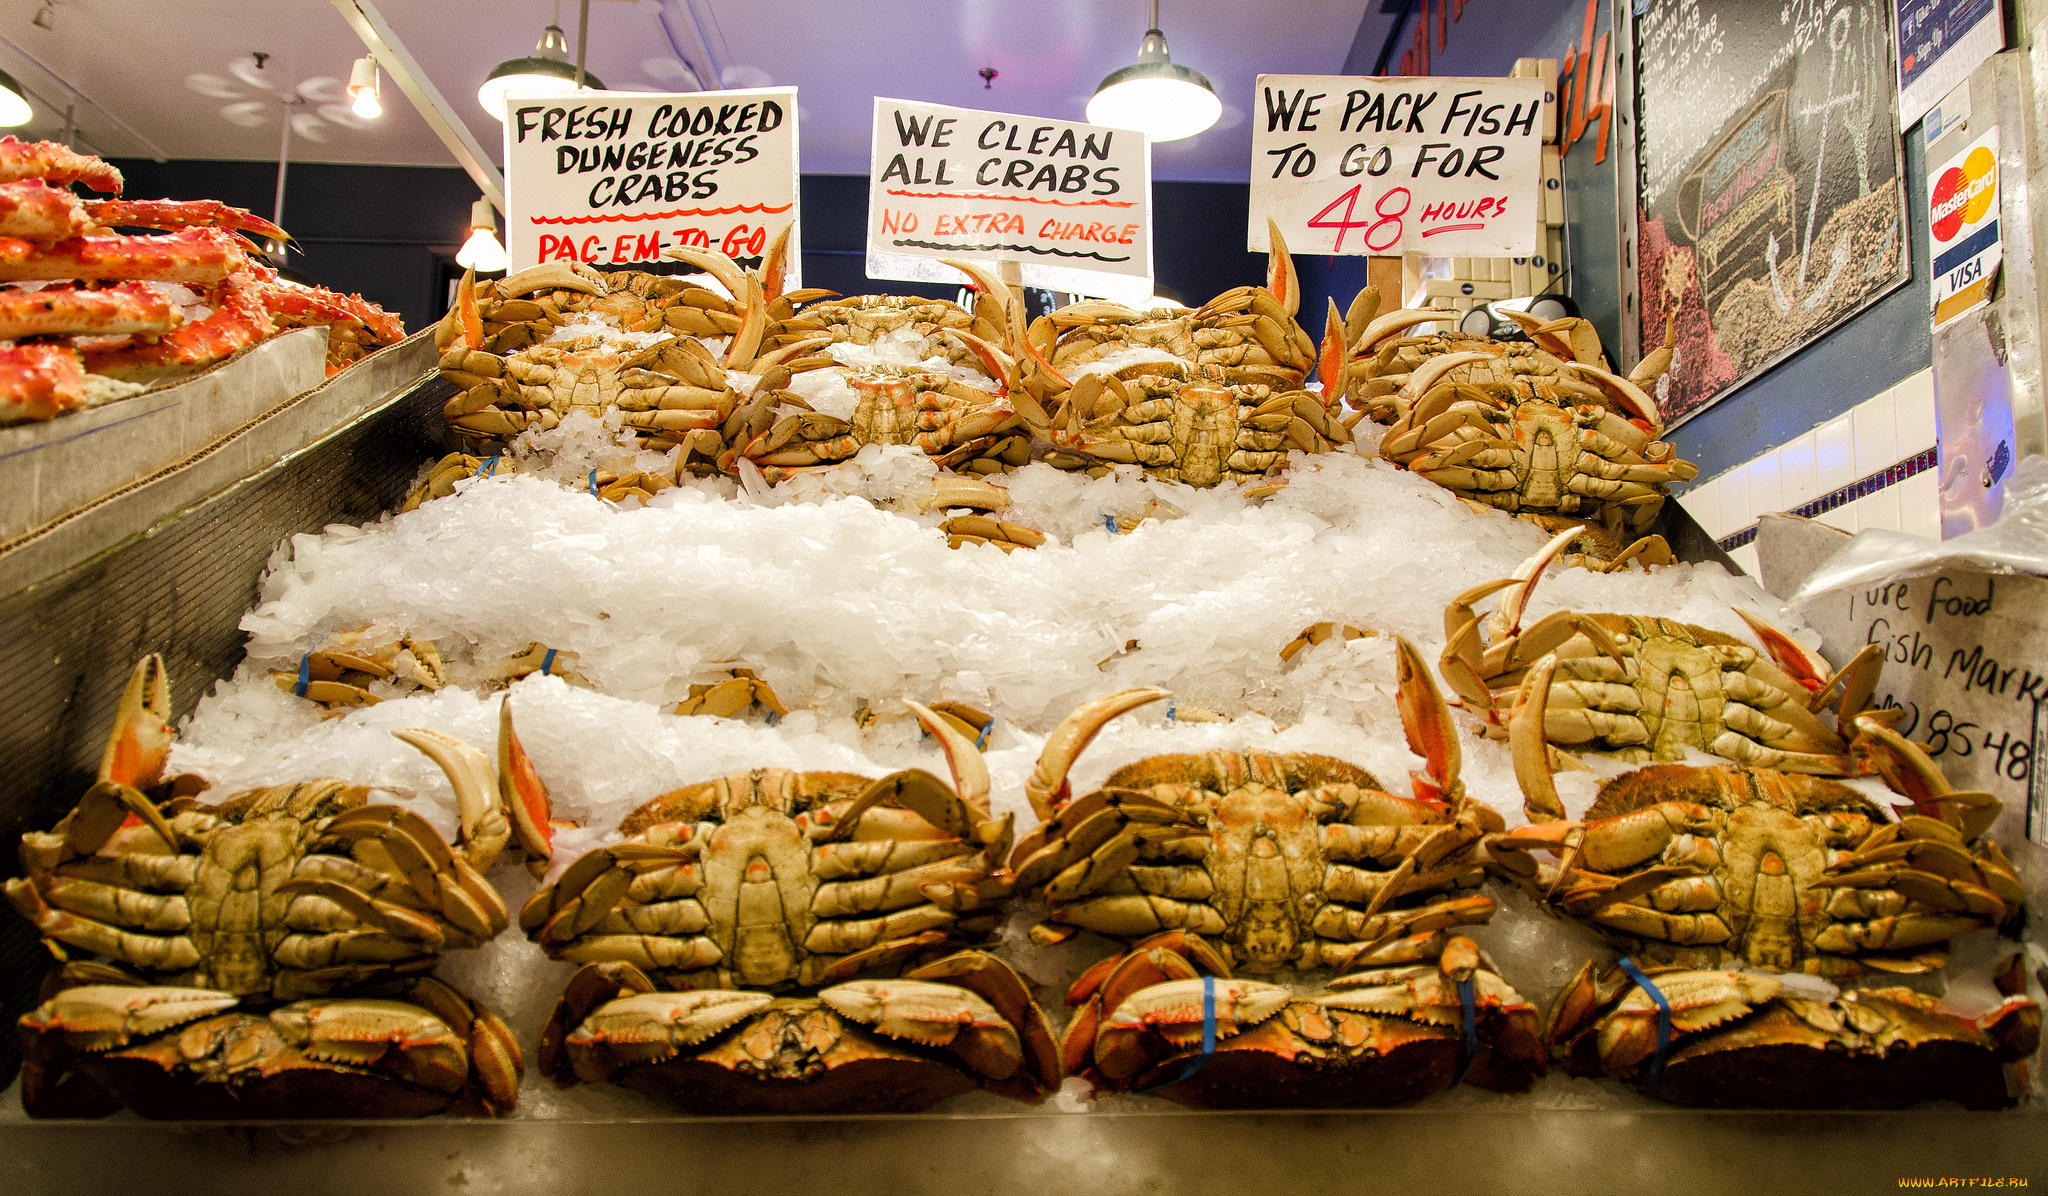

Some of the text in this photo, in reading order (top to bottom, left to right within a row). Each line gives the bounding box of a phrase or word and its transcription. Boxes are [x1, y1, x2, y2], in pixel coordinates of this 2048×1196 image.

[1639, 8, 1678, 70] ALASKAN
[1639, 53, 1666, 95] KING
[1670, 4, 1700, 56] CRAB
[1641, 44, 1691, 118] DUNGENESS
[1693, 13, 1718, 54] CRAB
[516, 100, 783, 143] FRESH COOKED
[894, 110, 1113, 160] WE CLEAN
[1264, 86, 1540, 137] WE PACK FISH
[557, 135, 759, 174] DUNGENESS
[880, 153, 1120, 196] ALL CRABS
[1267, 142, 1505, 181] TO GO FOR
[588, 169, 718, 208] CRABS
[1701, 184, 1733, 235] FRESH
[1931, 165, 1995, 226] MasterCard
[881, 208, 1140, 245] NO EXTRA CHARGE
[1307, 183, 1509, 253] 48 HOURS
[1949, 257, 1982, 292] VISA
[1943, 644, 2048, 701] Mark
